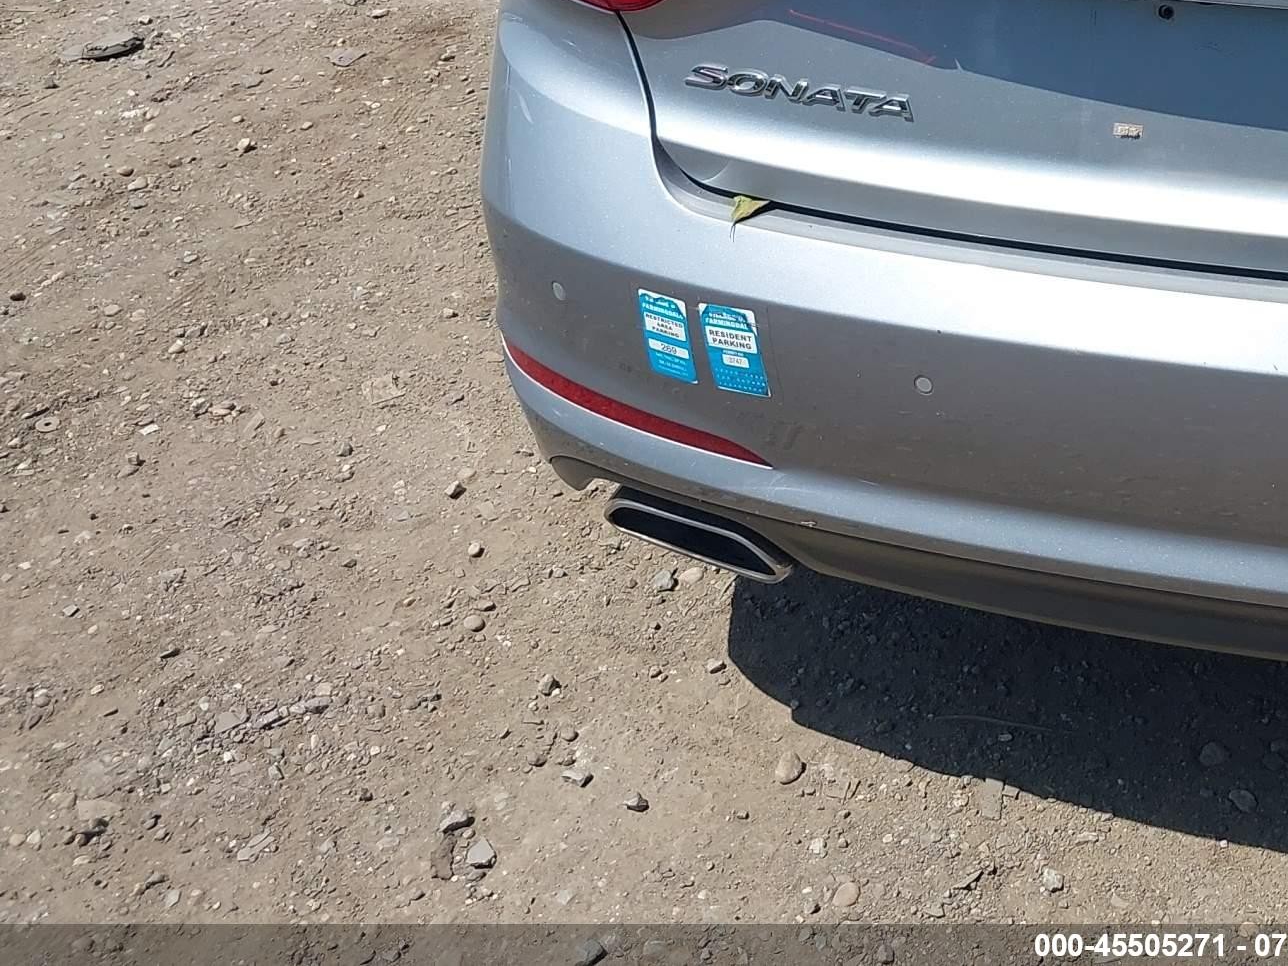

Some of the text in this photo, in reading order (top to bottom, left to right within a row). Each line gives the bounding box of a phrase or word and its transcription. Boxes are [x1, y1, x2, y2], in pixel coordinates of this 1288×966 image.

[684, 63, 914, 122] SONATA
[645, 313, 683, 329] RESTRICTED
[652, 326, 680, 338] PARKING
[709, 329, 752, 342] RESIDENT
[712, 337, 752, 350] PARKING
